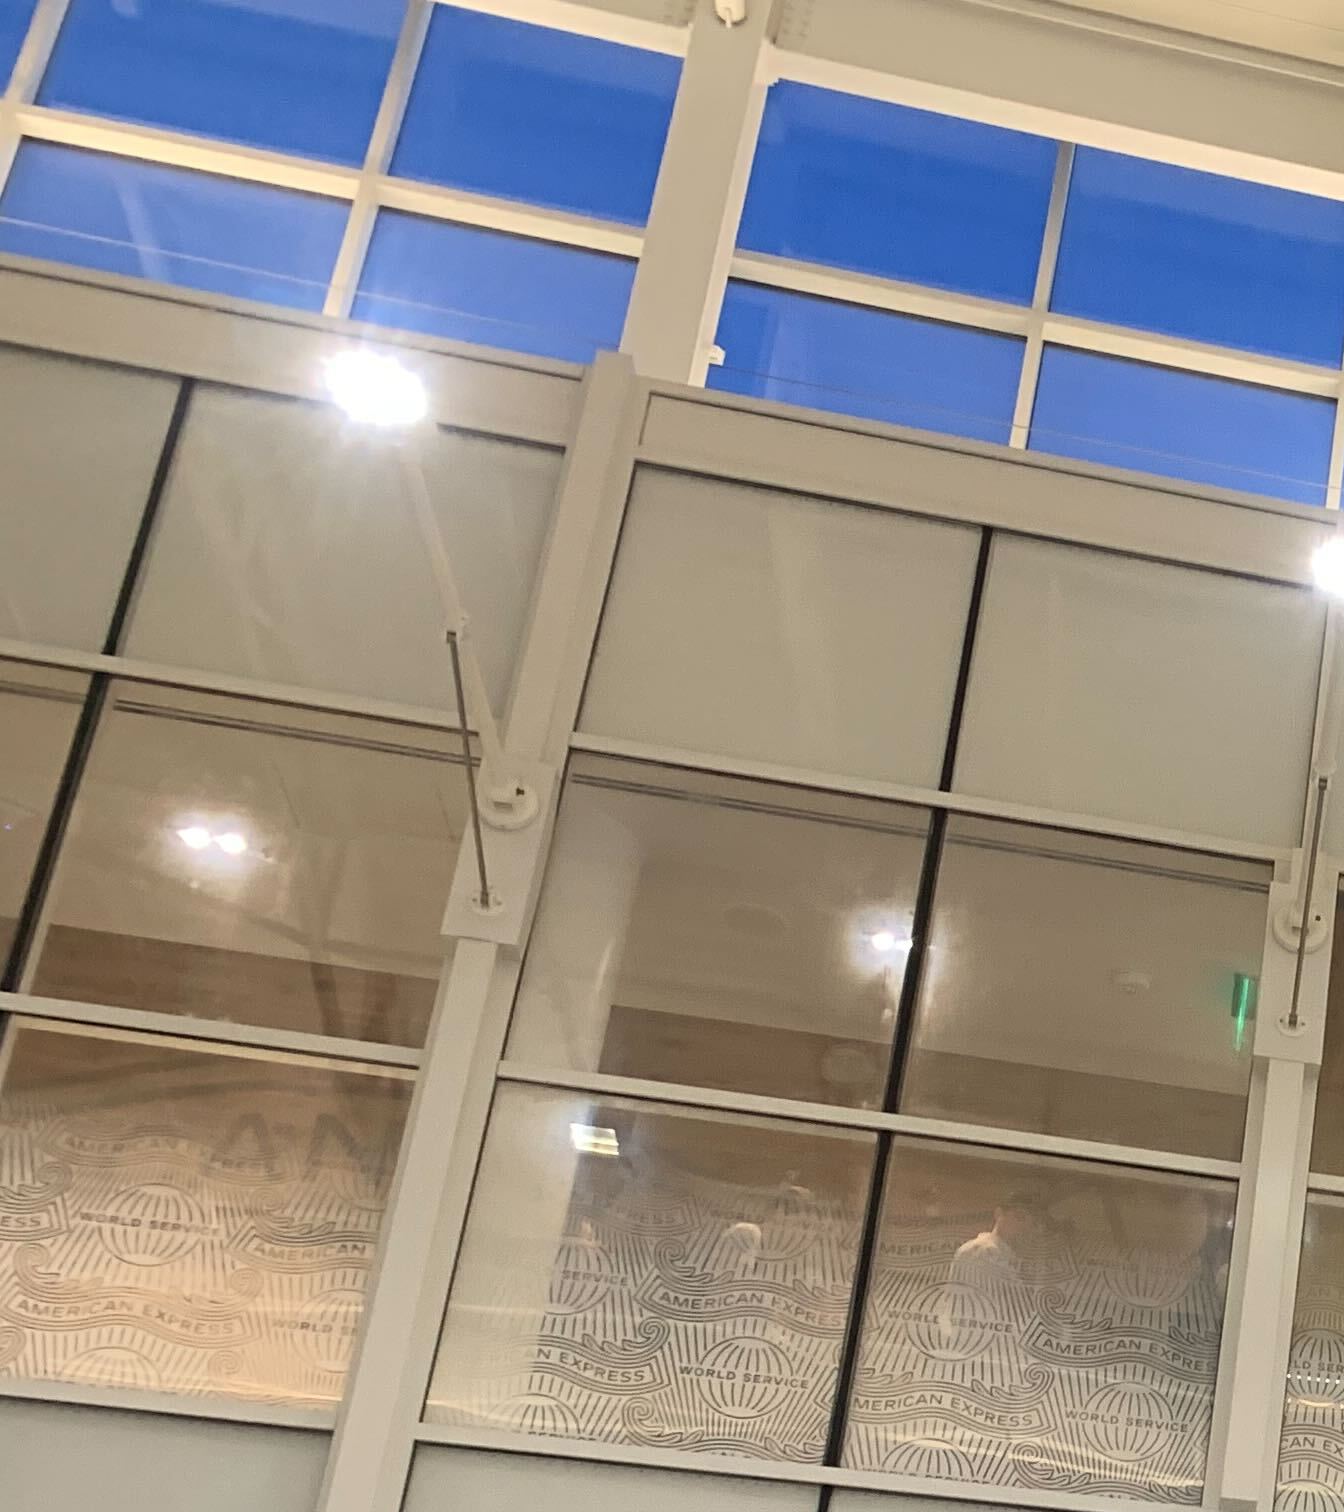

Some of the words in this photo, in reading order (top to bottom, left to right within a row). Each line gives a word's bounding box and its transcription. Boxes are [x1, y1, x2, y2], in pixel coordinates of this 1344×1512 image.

[80, 1211, 142, 1227] WORLD
[254, 1242, 366, 1261] AMERICAN
[561, 1269, 630, 1288] SERVICE
[18, 1299, 134, 1319] AMERICAN
[142, 1305, 234, 1336] EXPRESS
[658, 1290, 766, 1309] AMERICAN
[772, 1295, 842, 1328] EXPRES
[559, 1352, 646, 1384] EXPRESS
[1042, 1337, 1142, 1356] AMERICAN
[1149, 1344, 1216, 1373] EXPRES
[678, 1365, 736, 1382] WORLD
[743, 1373, 809, 1390] SERVICE
[855, 1393, 944, 1411] MERICAN
[950, 1398, 1033, 1427] EXPRESS
[1065, 1409, 1120, 1425] WORLD
[1125, 1416, 1191, 1433] SERVICE
